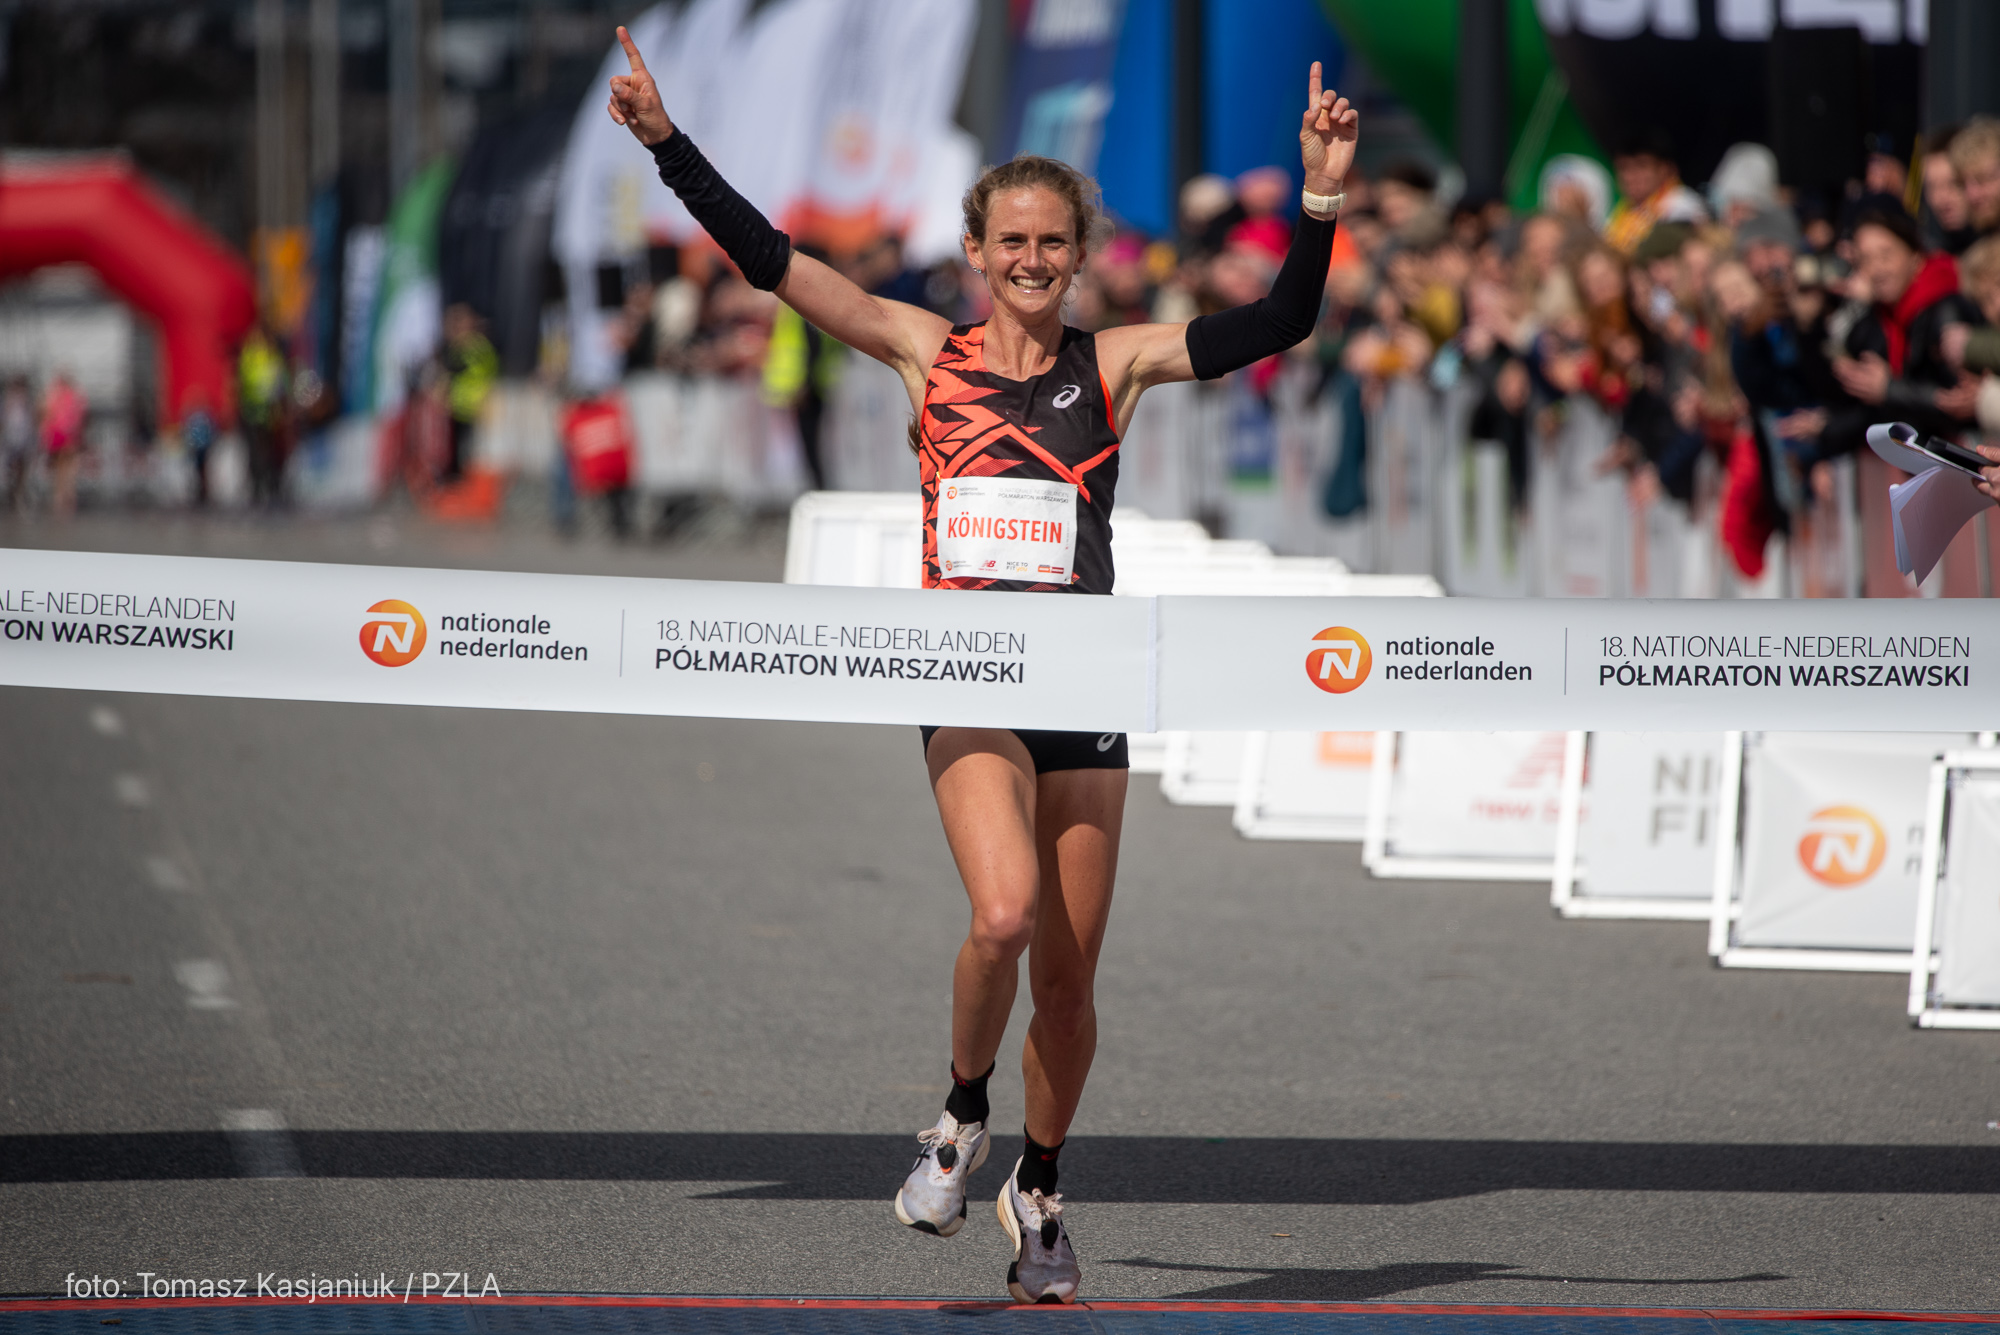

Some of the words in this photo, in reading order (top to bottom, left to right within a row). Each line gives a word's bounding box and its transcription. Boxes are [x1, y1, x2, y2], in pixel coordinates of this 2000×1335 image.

[947, 511, 1062, 544] KÖNIGSTEIN
[51, 621, 233, 651] WARSZAWSKI
[441, 612, 551, 635] nationale
[440, 637, 588, 661] nederlanden
[657, 620, 684, 641] 18.
[689, 620, 1025, 654] NATIONALE-NEDERLANDEN
[1386, 636, 1494, 656] nationale
[1600, 637, 1626, 657] 18.
[1633, 635, 1970, 658] NATIONALE-NEDERLANDEN
[655, 645, 837, 676] PÓŁMARATON
[845, 656, 1024, 683] WARSZAWSKI
[1386, 660, 1532, 680] nederlanden
[1599, 661, 1781, 687] PÓŁMARATON
[1789, 665, 1969, 687] WARSZAWSKI
